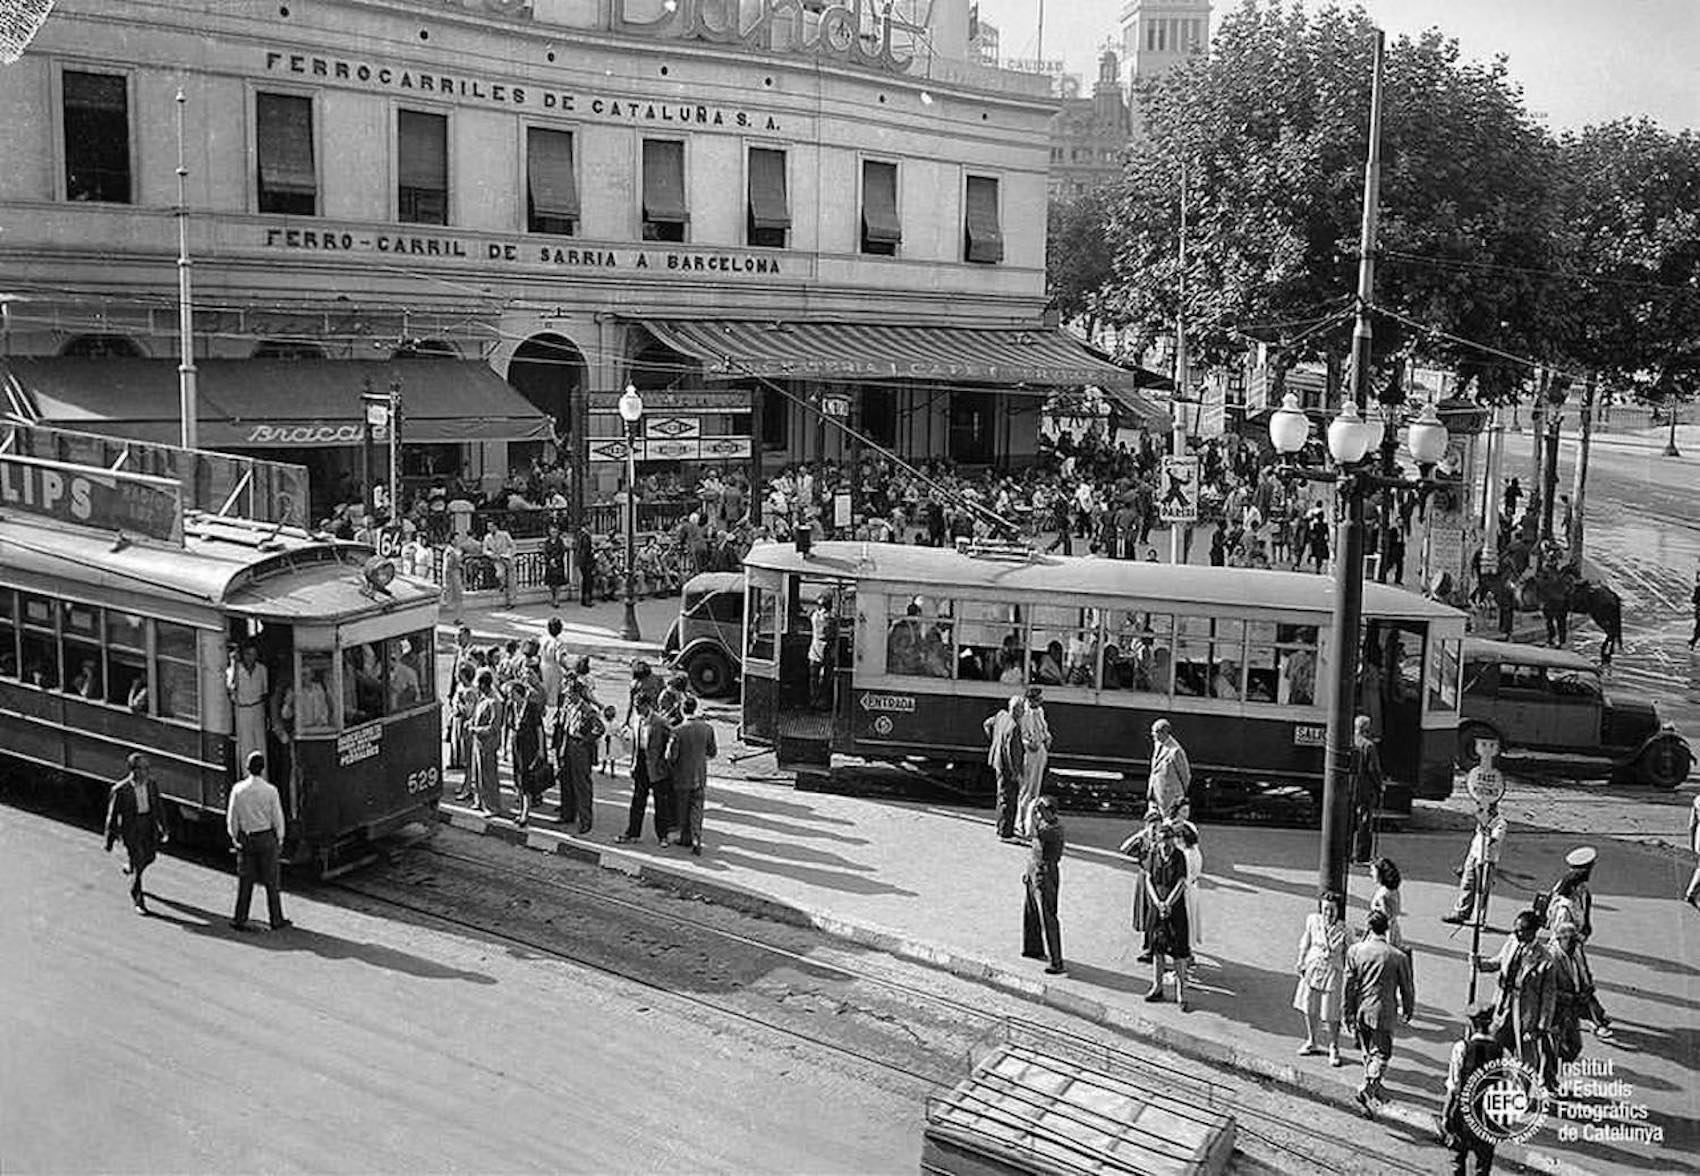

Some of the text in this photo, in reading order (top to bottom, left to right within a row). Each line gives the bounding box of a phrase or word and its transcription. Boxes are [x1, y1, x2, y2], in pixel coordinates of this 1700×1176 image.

[266, 52, 781, 131] FERROCARRILES DE CATALUÑA S. A.
[488, 243, 517, 261] DE
[540, 247, 616, 267] SARRIA
[637, 253, 648, 268] A
[667, 254, 780, 274] BARCELONA
[248, 424, 388, 443] Bracae
[380, 532, 400, 557] 64
[869, 695, 915, 711] ENTRADA
[407, 767, 439, 794] 529
